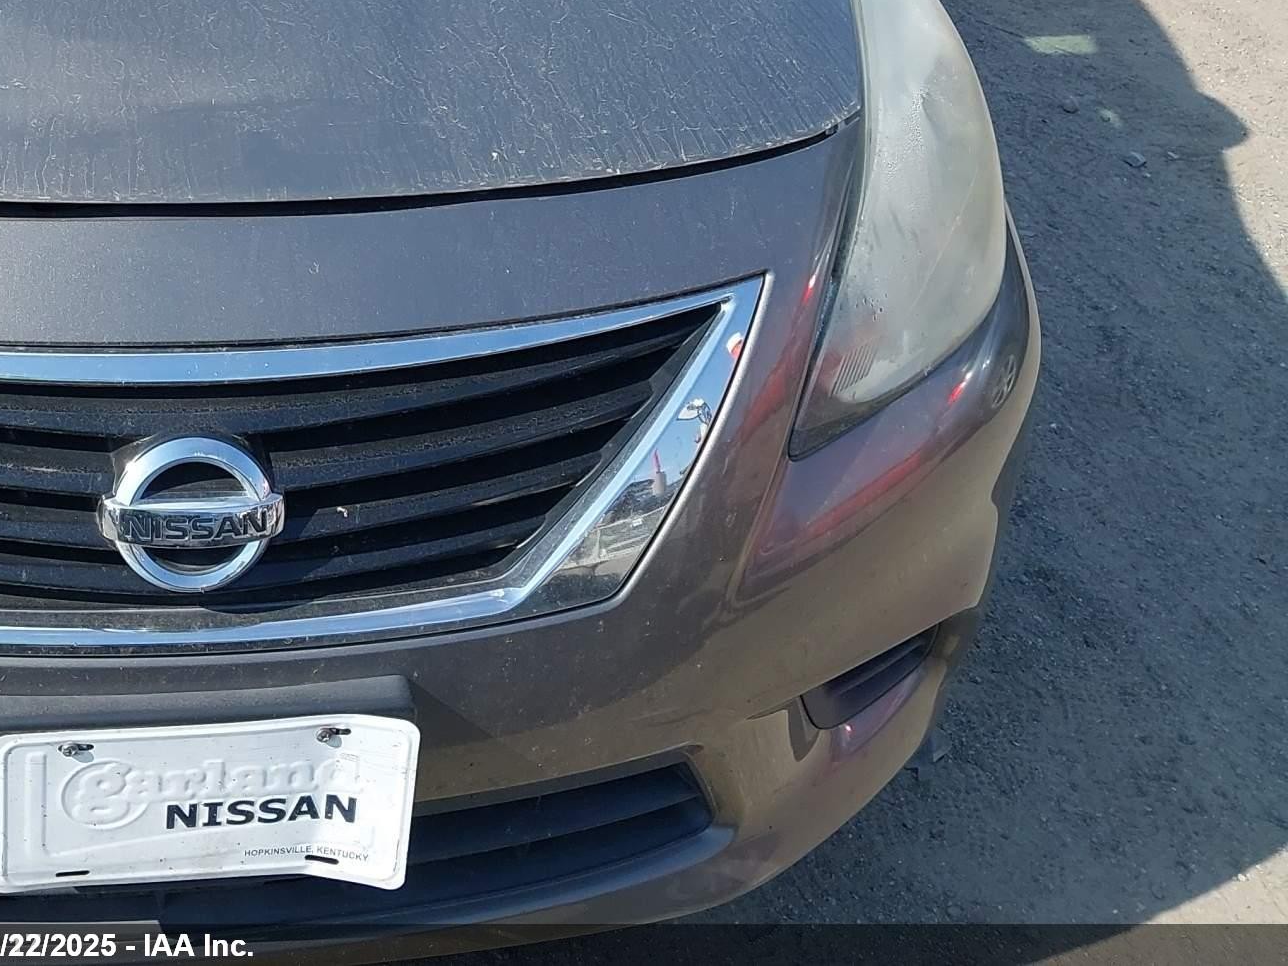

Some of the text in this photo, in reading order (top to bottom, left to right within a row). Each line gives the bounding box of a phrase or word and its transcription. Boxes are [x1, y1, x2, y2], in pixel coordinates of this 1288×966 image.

[124, 508, 268, 540] NISSAN
[166, 795, 357, 829] NISSAN
[244, 845, 369, 862] HOPKINSVILLE, KENTUCKY
